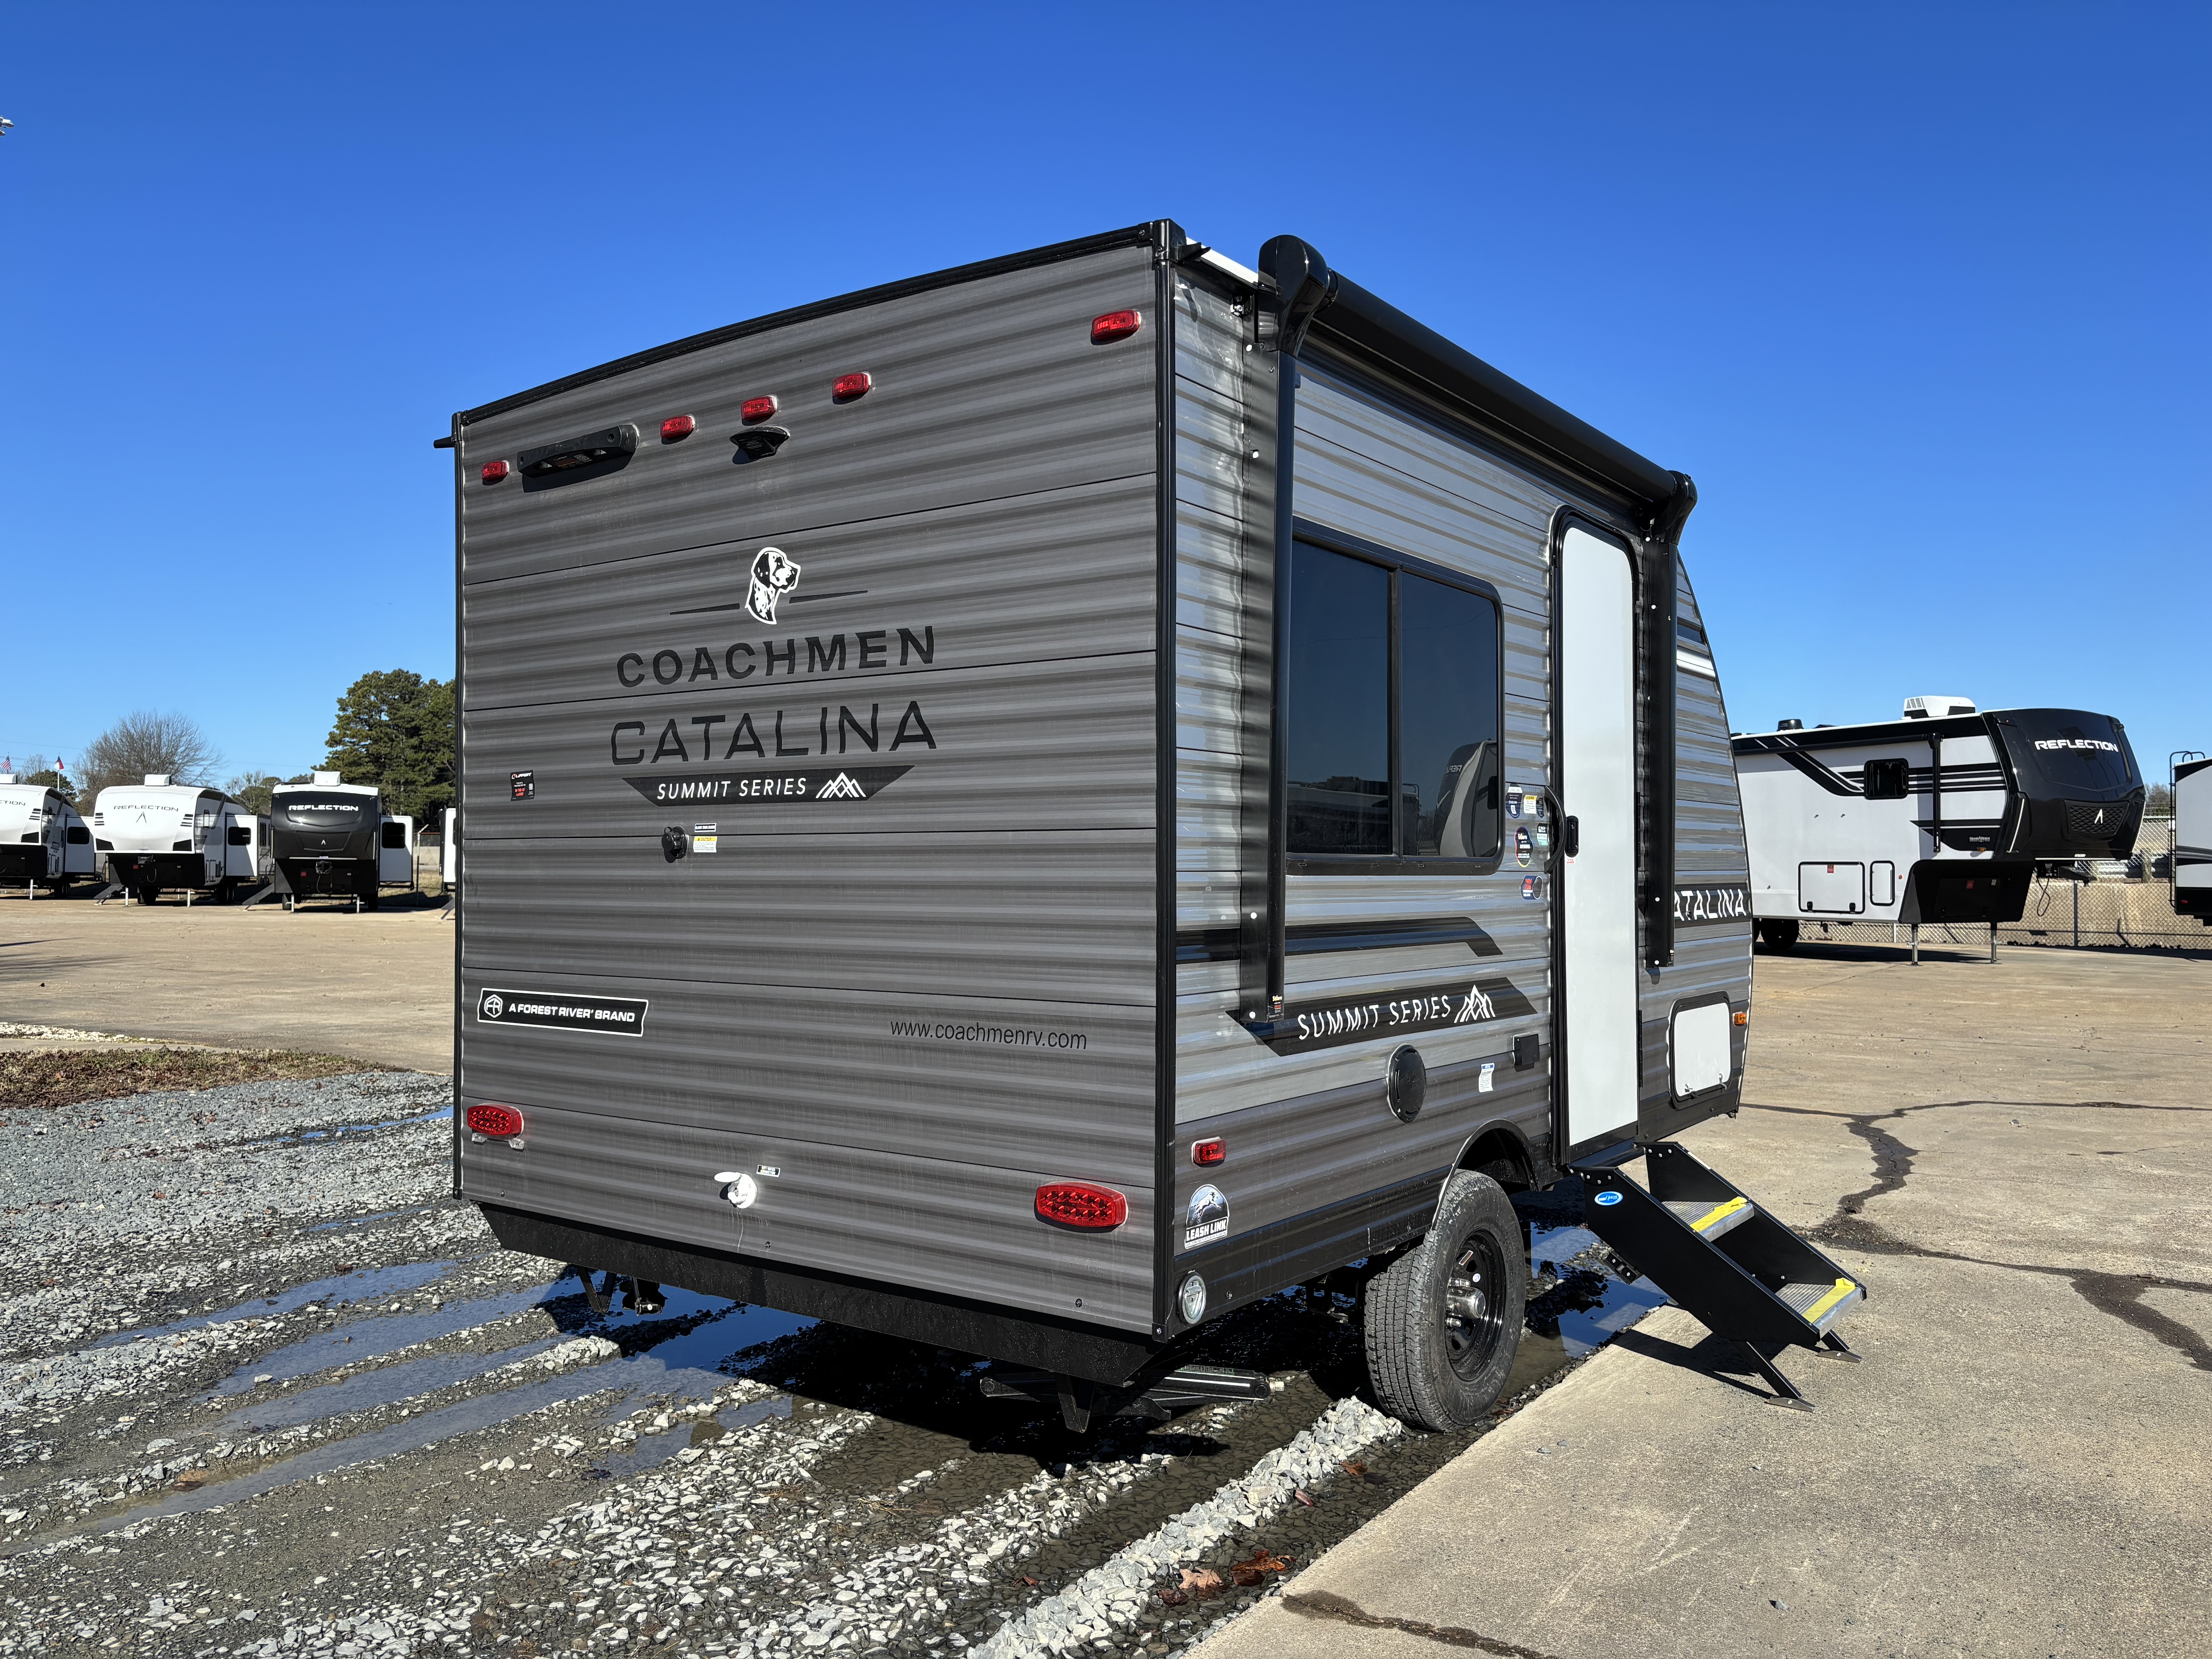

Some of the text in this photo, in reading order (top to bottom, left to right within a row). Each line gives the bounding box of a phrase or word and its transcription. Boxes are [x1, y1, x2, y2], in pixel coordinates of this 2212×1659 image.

[617, 625, 934, 687] COACHMEN
[611, 701, 937, 765] CATALINA
[2034, 739, 2119, 752] REFLECTION
[657, 778, 807, 800] SUMMIT SERIES
[1674, 888, 1747, 921] ATALINA
[508, 1003, 517, 1013] A
[517, 1004, 558, 1015] FOREST
[594, 1010, 635, 1022] BRAND
[1297, 994, 1451, 1040] SUMMIT SERIES
[890, 1021, 1087, 1049] www.coachmenrv.com
[1186, 1224, 1209, 1241] LEASH
[1210, 1219, 1227, 1234] LINK
